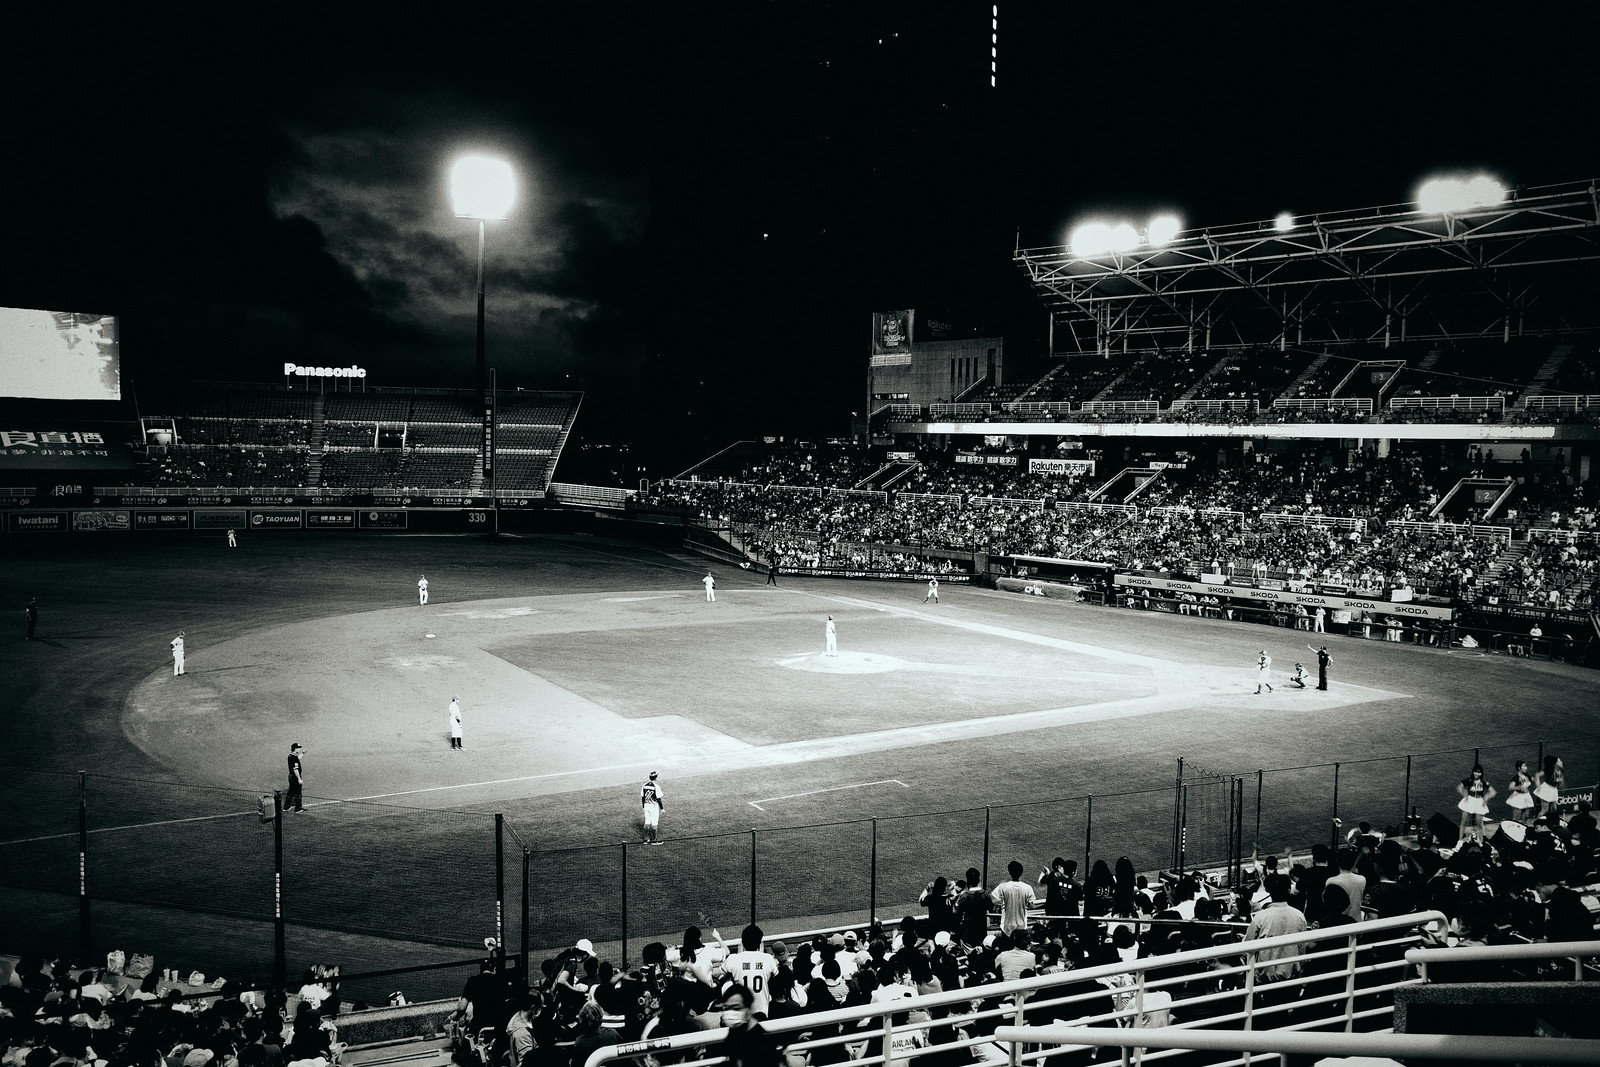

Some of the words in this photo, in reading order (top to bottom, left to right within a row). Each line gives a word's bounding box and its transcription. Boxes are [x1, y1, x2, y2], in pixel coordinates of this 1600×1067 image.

[284, 362, 367, 378] Panasonic
[1031, 461, 1063, 471] Rakuten
[18, 516, 59, 525] Iwatani
[468, 512, 486, 523] 330
[1557, 794, 1579, 806] Global
[743, 975, 764, 993] 10
